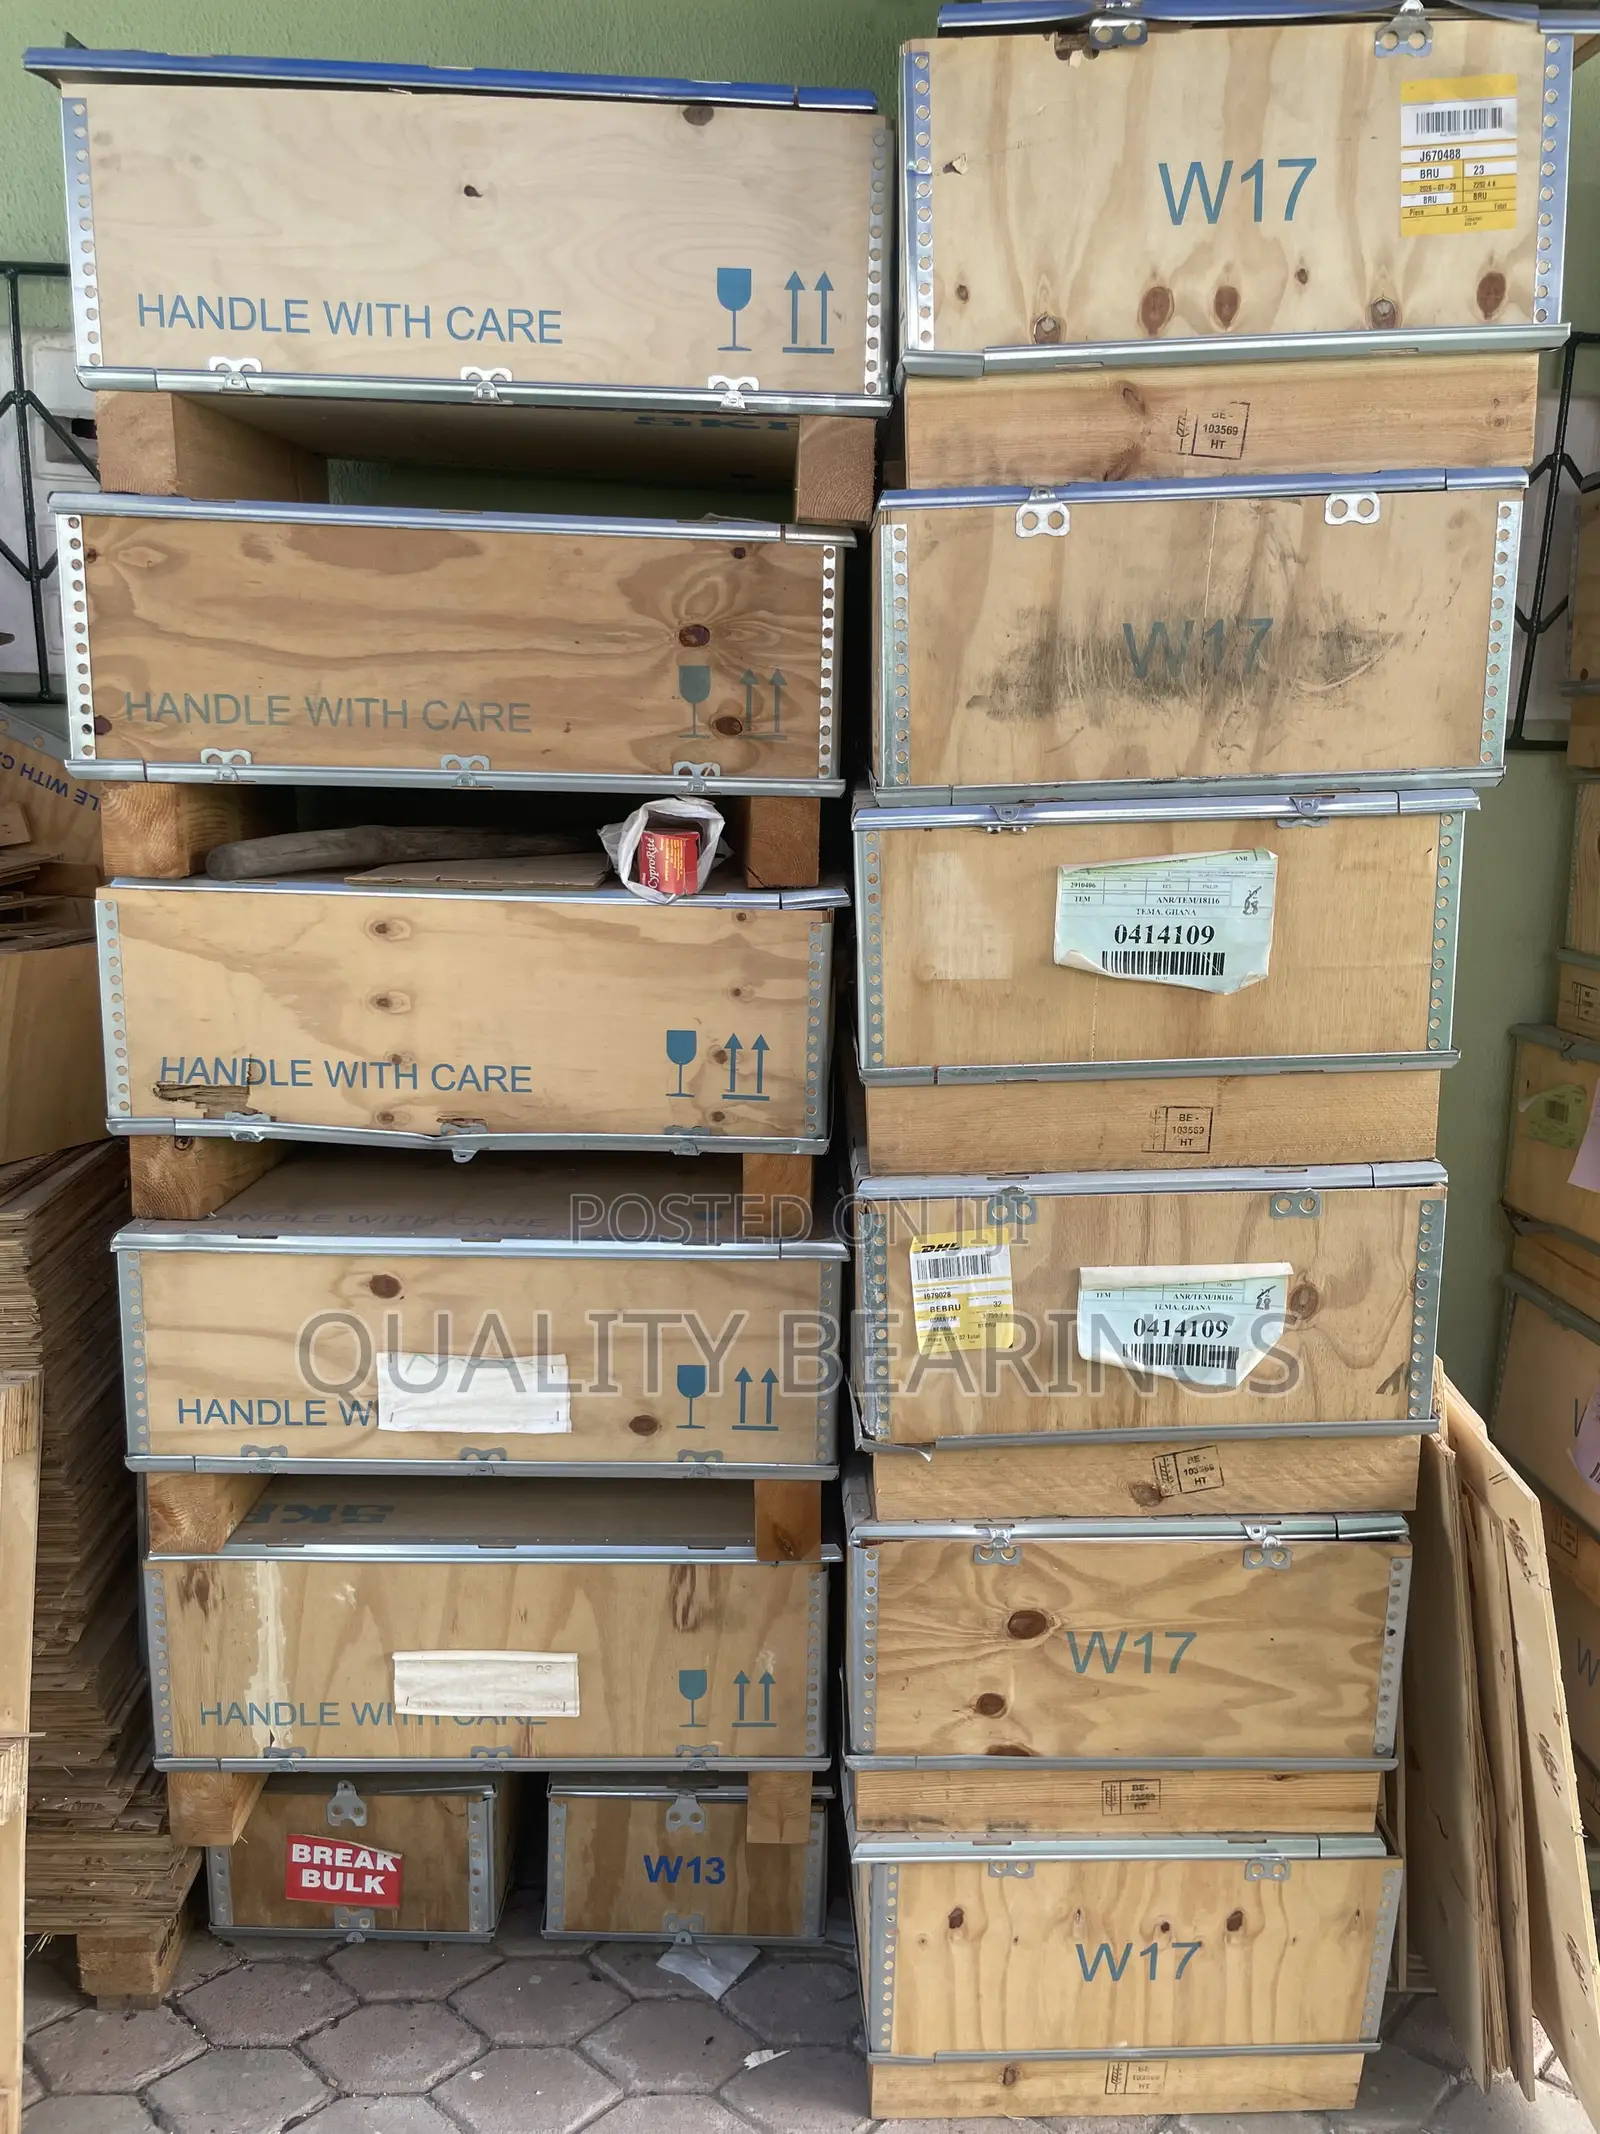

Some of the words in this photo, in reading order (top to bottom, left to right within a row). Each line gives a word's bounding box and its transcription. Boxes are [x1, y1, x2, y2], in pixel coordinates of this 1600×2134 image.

[1420, 148, 1461, 162] J670488
[1420, 168, 1440, 179] BRU
[1474, 164, 1484, 176] 23
[1158, 158, 1317, 226] W17
[1423, 196, 1437, 204] BRU
[1473, 192, 1487, 200] BRU
[137, 293, 310, 334] HANDLE
[324, 300, 430, 338] WITH
[446, 306, 562, 344] CARE
[1203, 424, 1238, 436] 103569
[1211, 440, 1226, 449] HT
[1122, 618, 1274, 679] W17
[124, 691, 291, 726] HANDLE
[305, 696, 408, 730] WITH
[422, 700, 532, 734] CARE
[20, 763, 68, 798] WITH
[646, 837, 660, 889] CyproRite
[1165, 908, 1197, 916] GHANA
[1114, 924, 1215, 945] 0414109
[160, 1056, 313, 1087] HANDLE
[324, 1060, 418, 1090] WITH
[431, 1064, 532, 1093] CARE
[1172, 1126, 1204, 1134] 103569
[1180, 1138, 1194, 1146] HT
[350, 1214, 436, 1225] WITH
[452, 1216, 551, 1227] CARE
[921, 1242, 960, 1253] DHL
[930, 1304, 961, 1313] BEBRU
[1133, 1318, 1228, 1338] 0414109
[178, 1398, 328, 1426] HANDLE
[1194, 1477, 1207, 1485] HT
[1066, 1631, 1197, 1674] W17
[200, 1701, 341, 1726] HANDLE
[292, 1844, 397, 1872] BREAK
[644, 1854, 726, 1886] W13
[301, 1868, 386, 1895] BULK
[1075, 1942, 1202, 1982] W17
